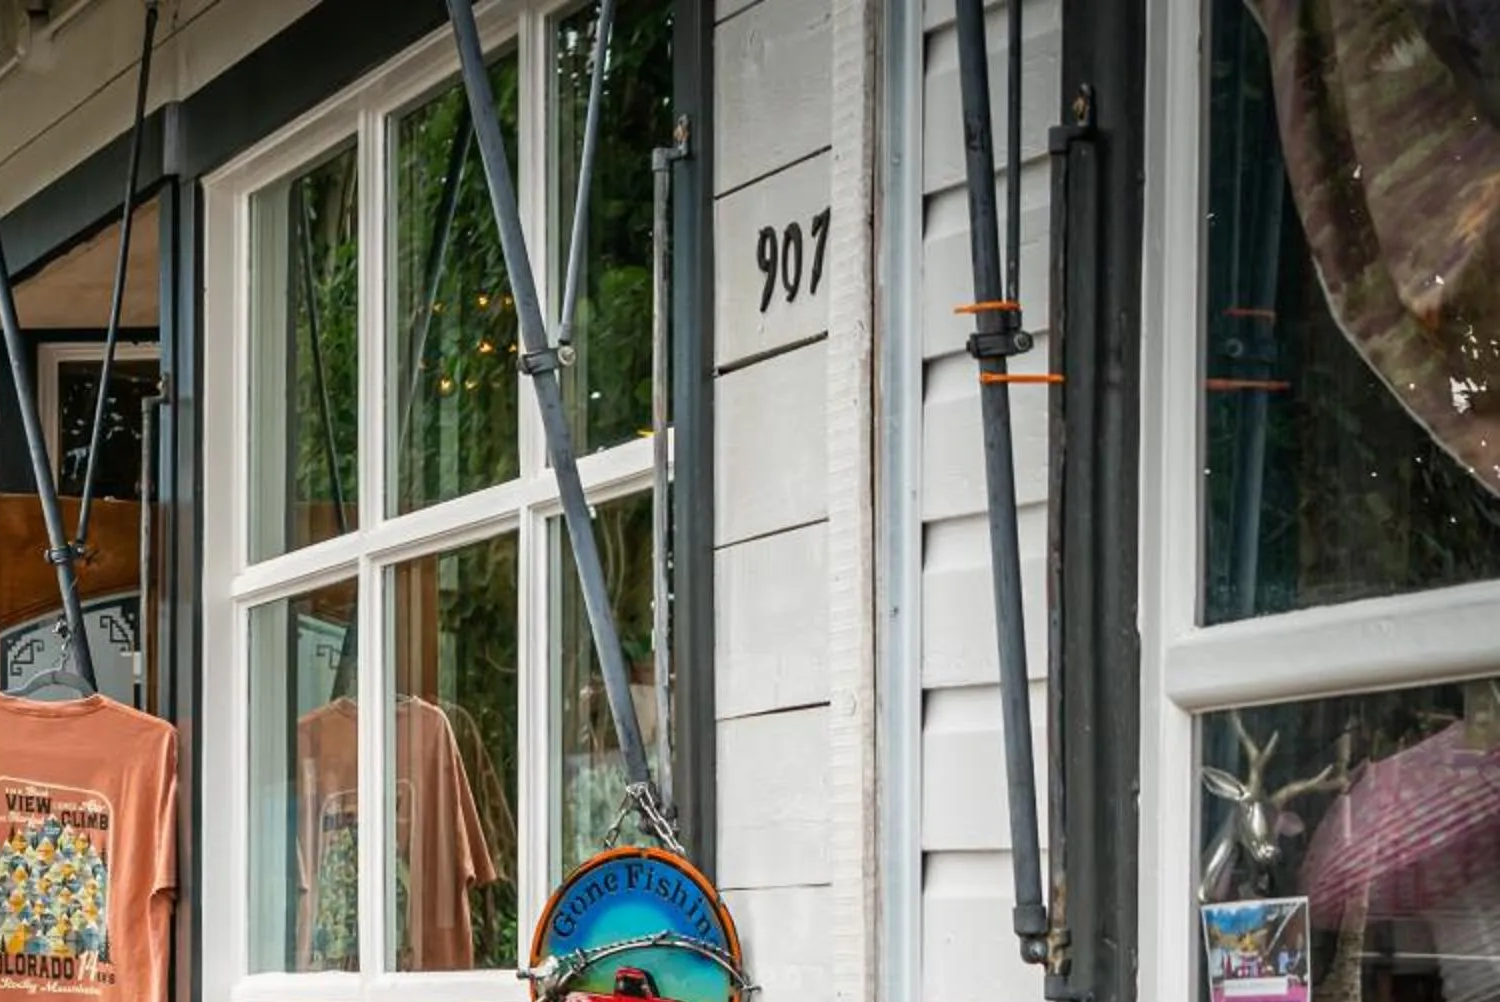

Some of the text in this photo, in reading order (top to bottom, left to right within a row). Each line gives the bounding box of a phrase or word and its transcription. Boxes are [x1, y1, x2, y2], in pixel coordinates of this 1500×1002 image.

[757, 205, 831, 313] 907
[5, 793, 52, 814] VIEW
[61, 811, 109, 830] CLIMB
[552, 863, 718, 945] Gone Fishin
